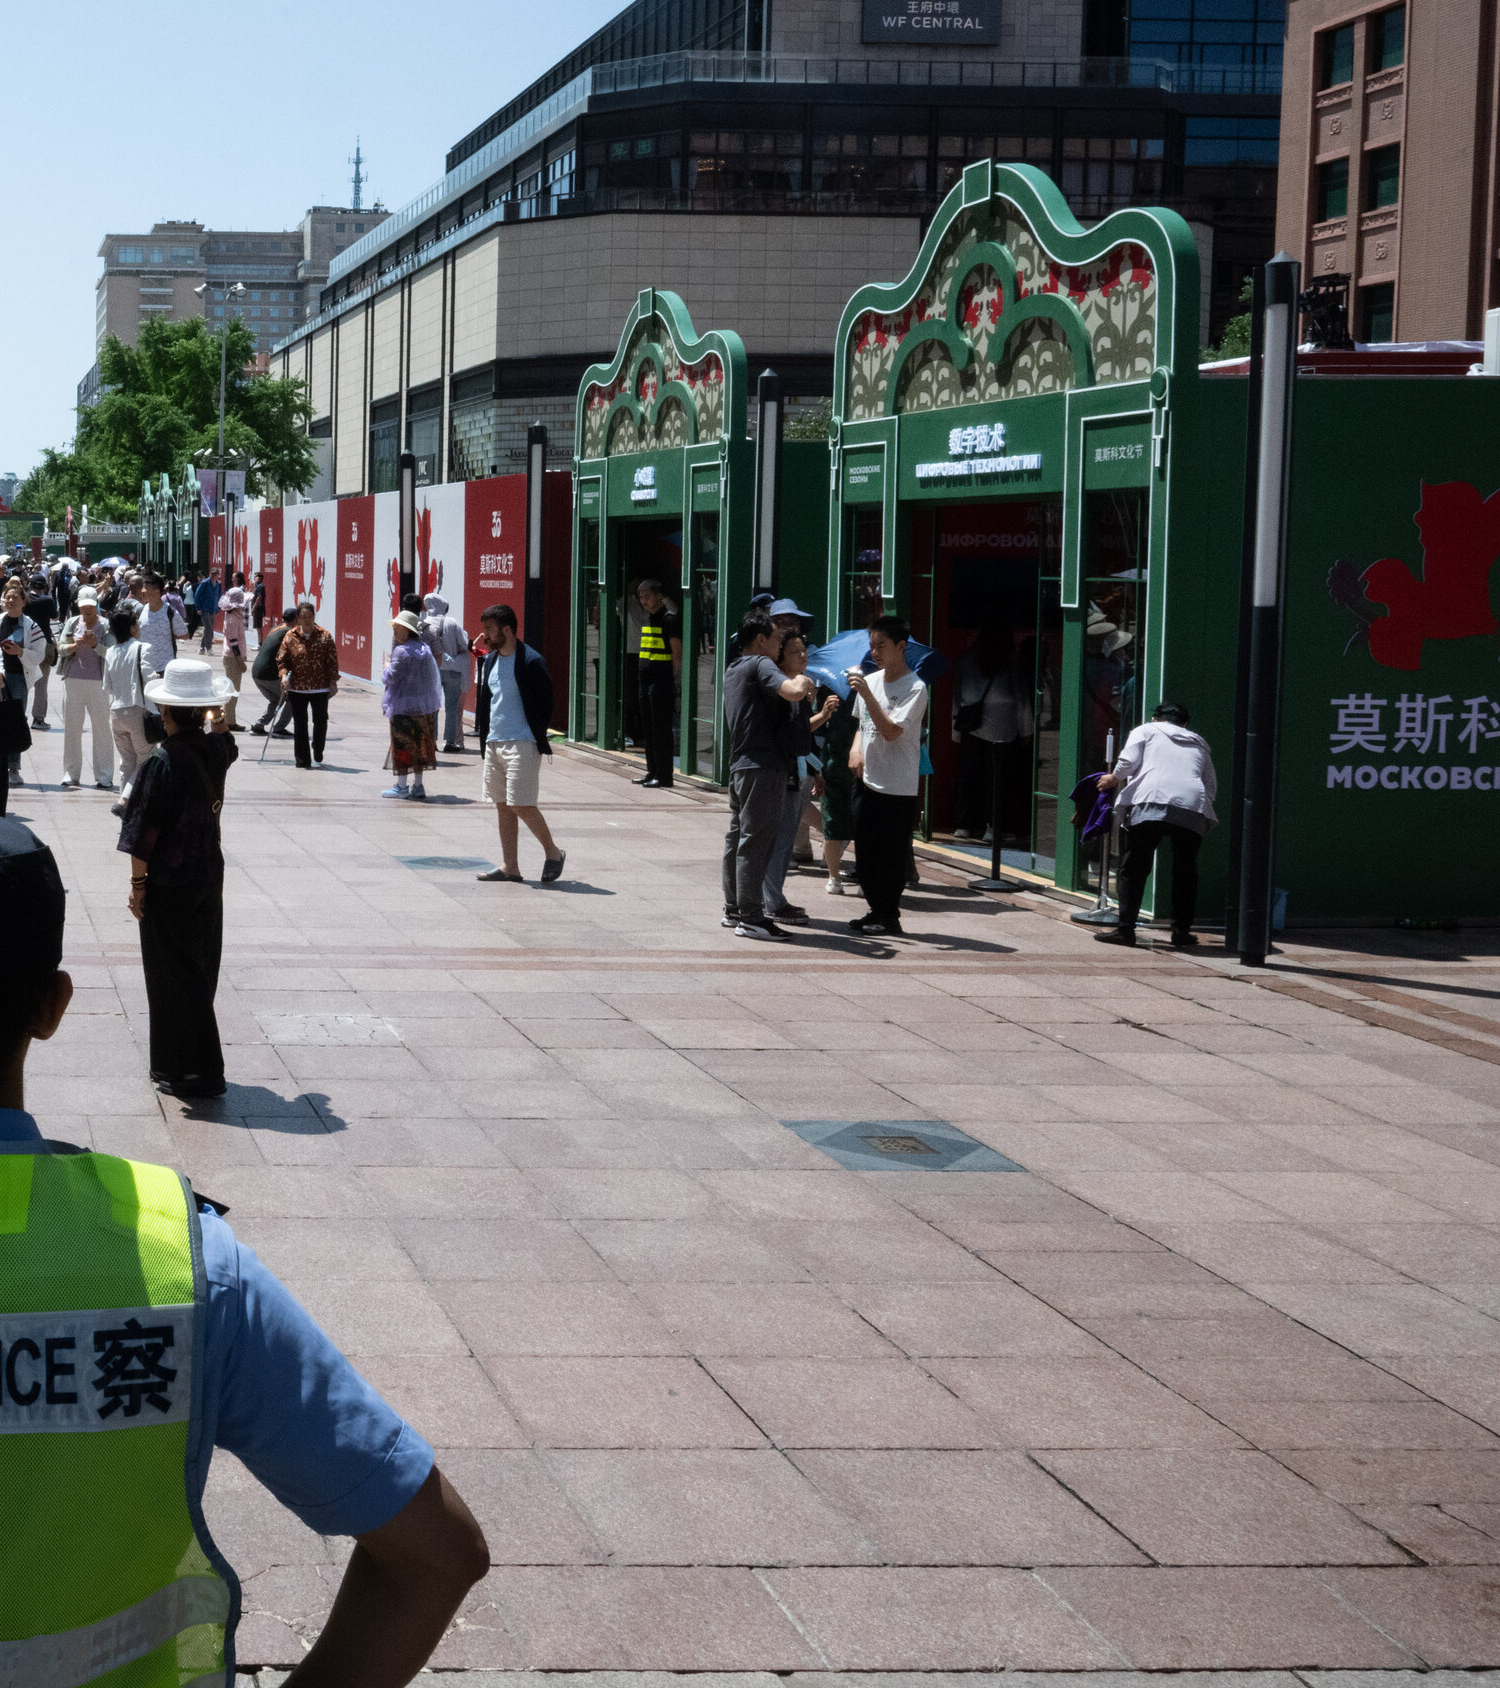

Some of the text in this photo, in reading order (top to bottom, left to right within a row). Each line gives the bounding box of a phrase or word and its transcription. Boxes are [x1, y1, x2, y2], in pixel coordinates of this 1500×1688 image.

[882, 16, 983, 29] WF CENTRAL
[91, 1318, 178, 1420] 察
